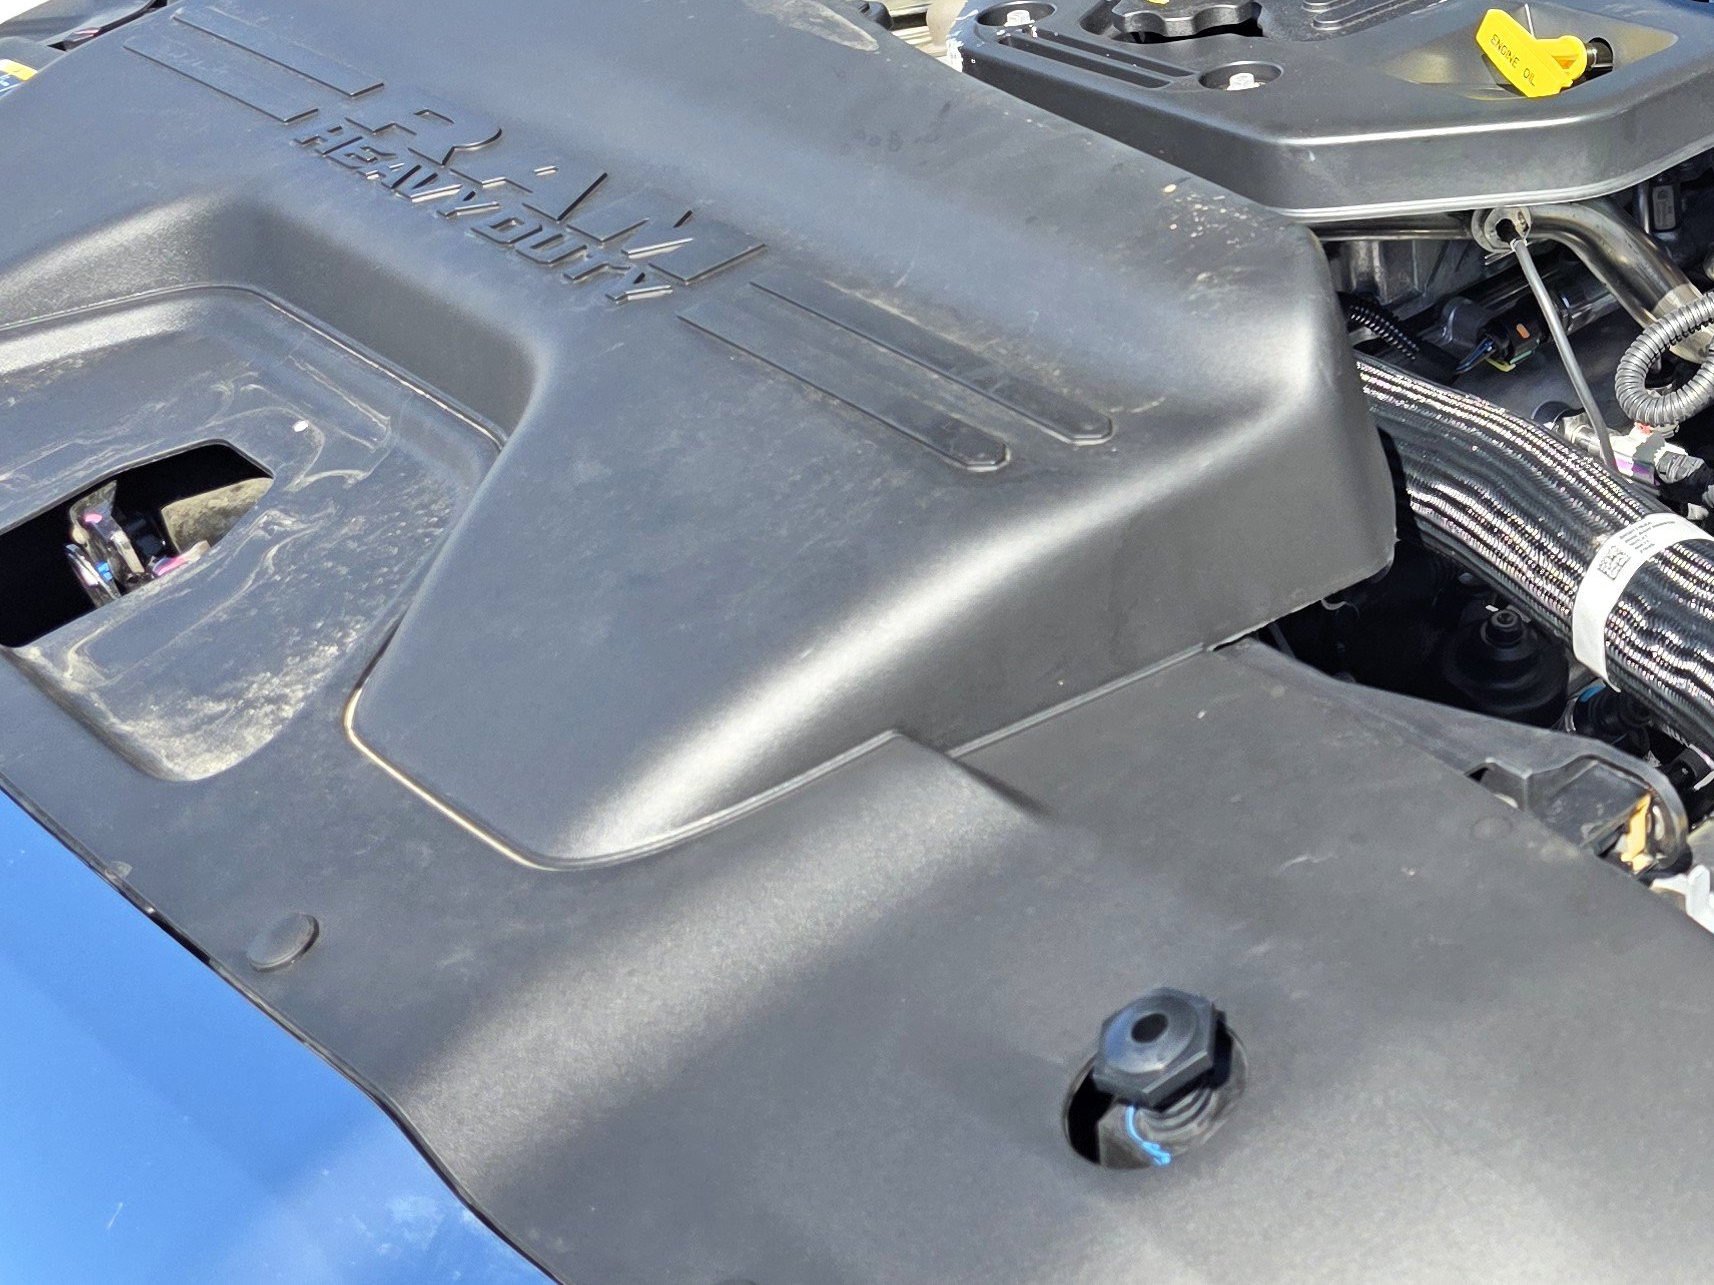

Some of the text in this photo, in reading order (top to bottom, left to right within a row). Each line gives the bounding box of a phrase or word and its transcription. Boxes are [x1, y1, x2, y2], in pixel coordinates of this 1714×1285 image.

[1490, 33, 1536, 87] ENGINE OIL
[293, 124, 673, 305] HEAVY DUTY
[344, 107, 767, 286] RAM
